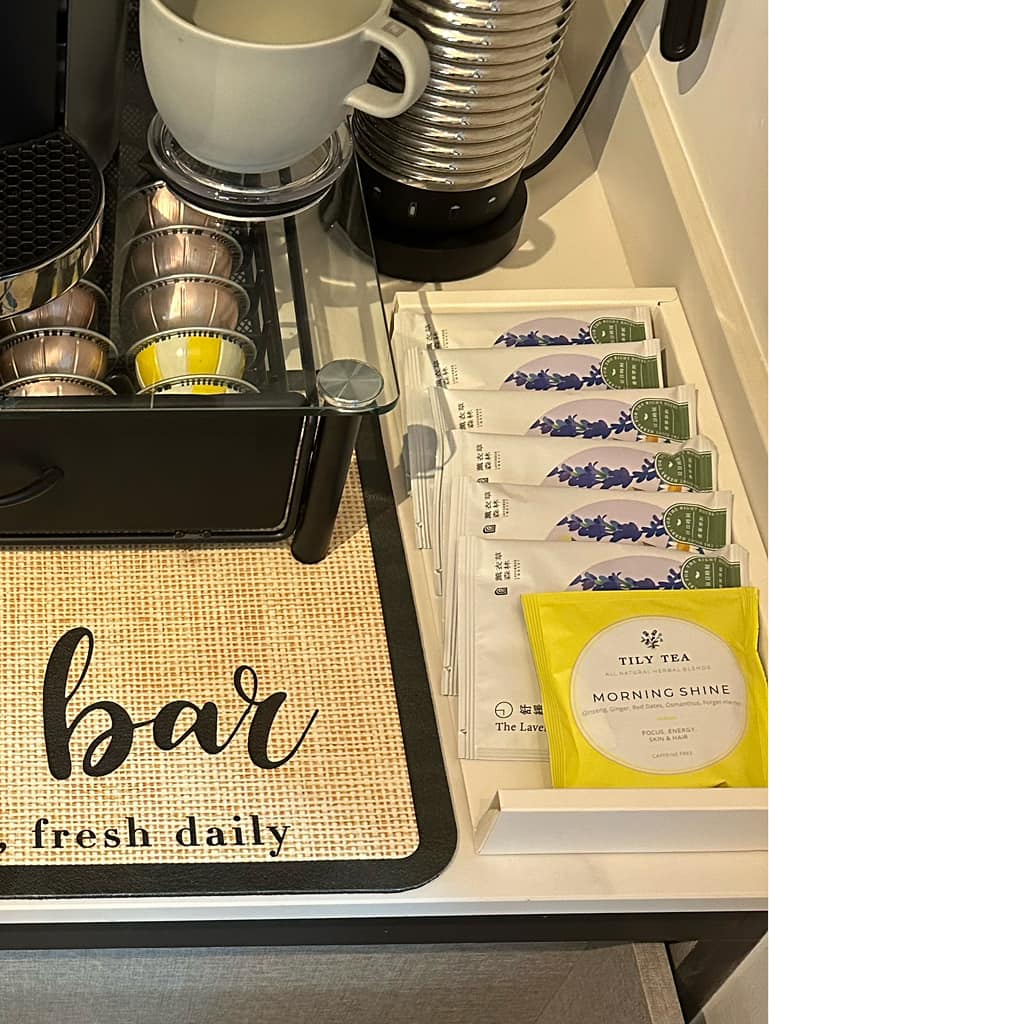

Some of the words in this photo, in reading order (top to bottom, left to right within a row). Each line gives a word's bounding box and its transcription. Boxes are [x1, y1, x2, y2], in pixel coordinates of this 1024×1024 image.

[618, 655, 653, 666] TILY
[661, 653, 691, 663] TEA
[593, 687, 674, 703] MORNING
[680, 684, 731, 697] SHINE
[43, 626, 320, 781] bar
[495, 722, 516, 732] The
[31, 818, 151, 849] fresh
[176, 815, 291, 858] daily
